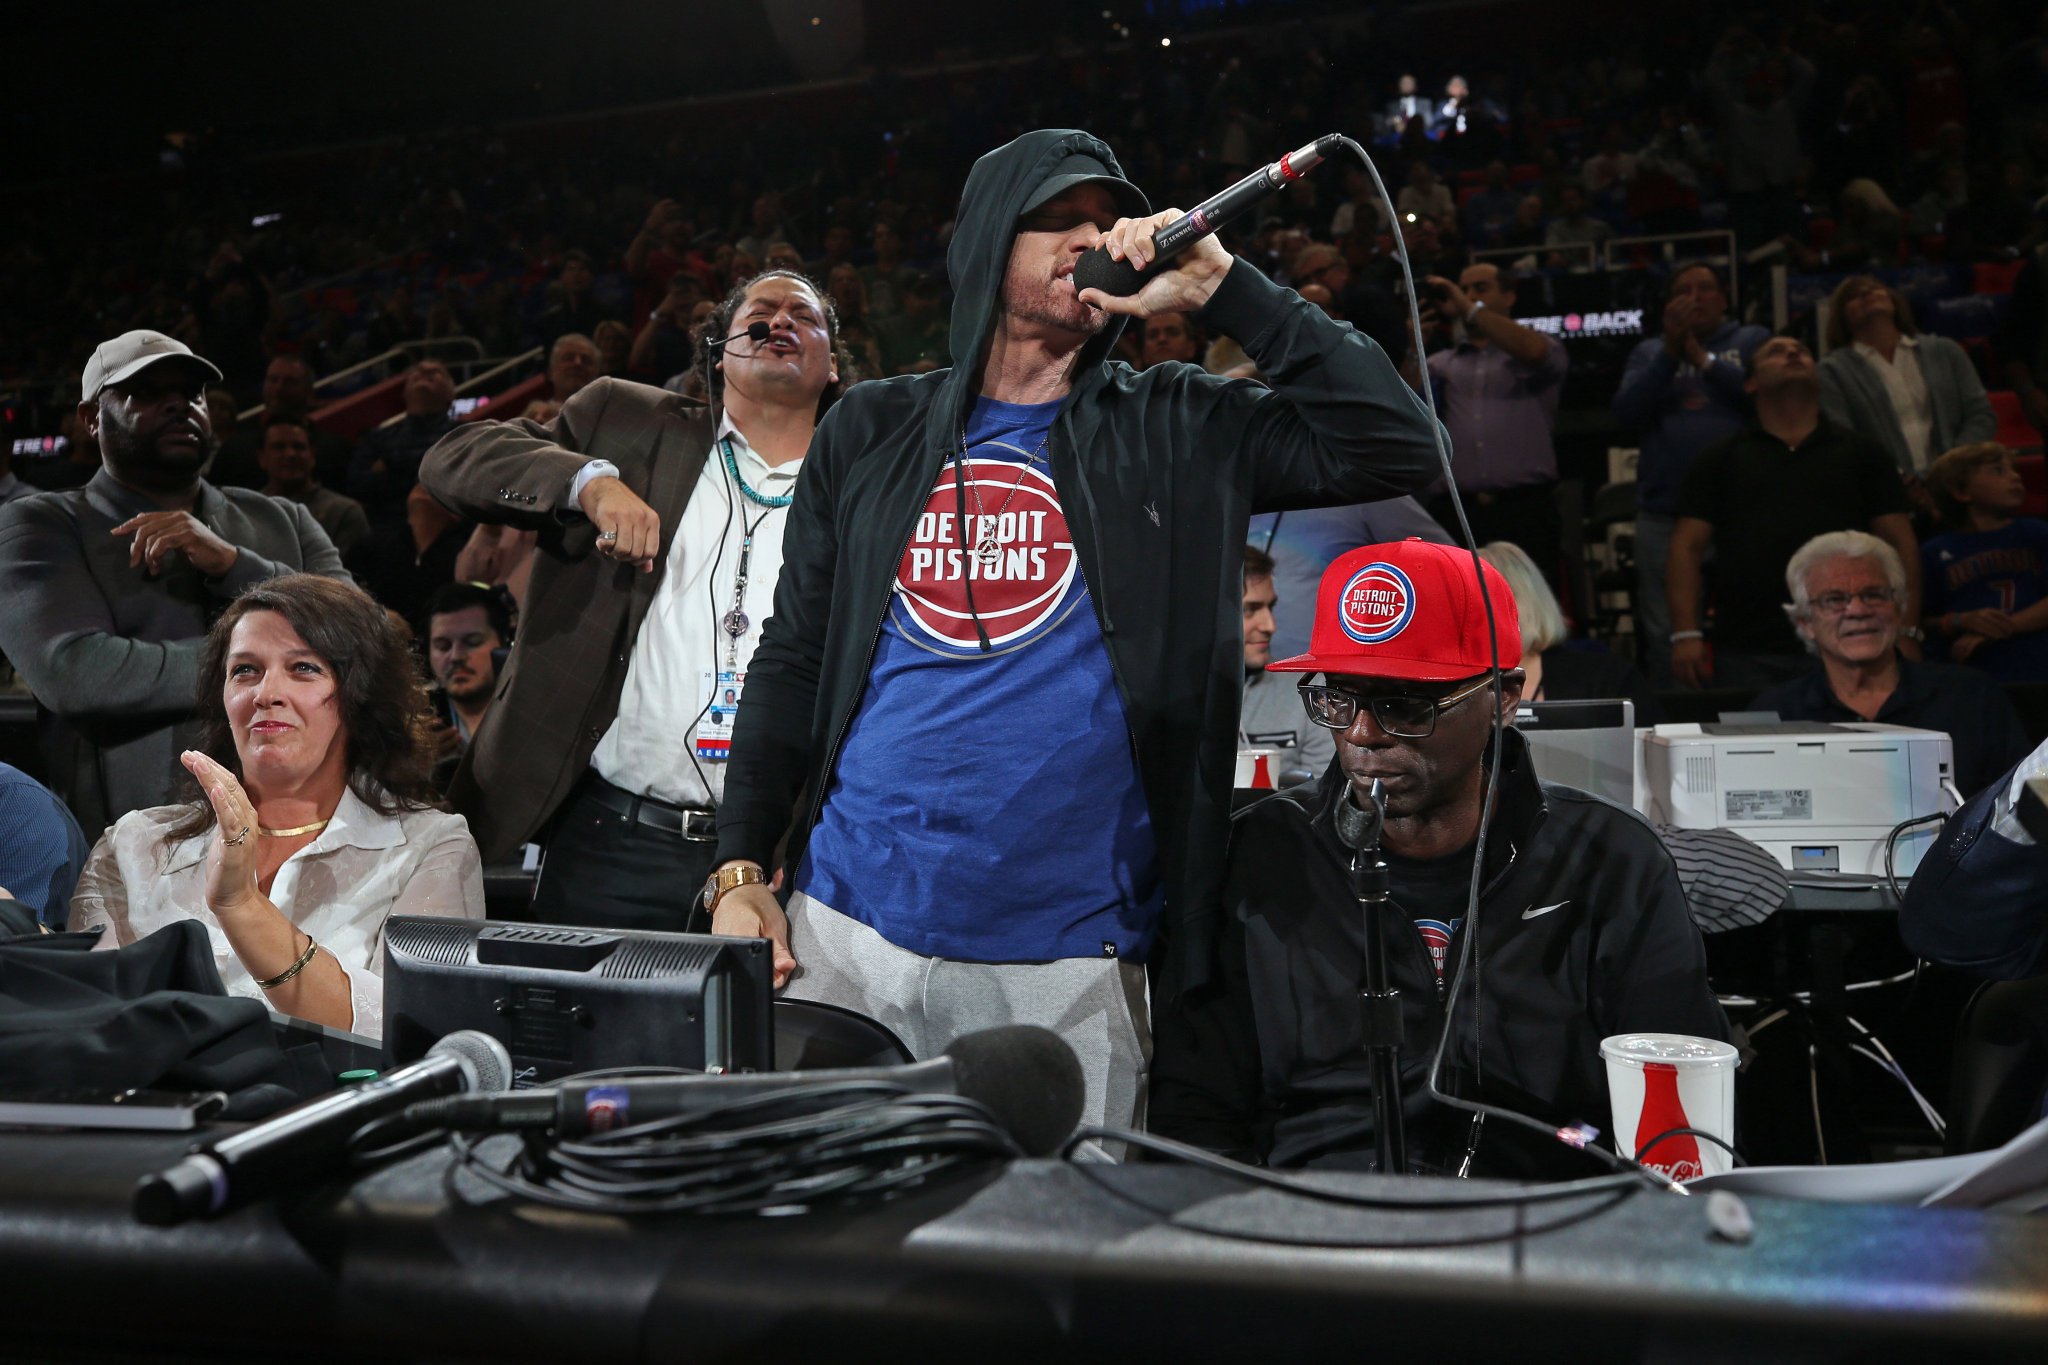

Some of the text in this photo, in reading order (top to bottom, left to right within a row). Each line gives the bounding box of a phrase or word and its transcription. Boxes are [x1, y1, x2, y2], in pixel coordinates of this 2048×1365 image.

[1583, 309, 1644, 331] BACK
[915, 510, 1048, 544] DETROIT
[910, 547, 1048, 582] PISTONS
[1353, 589, 1398, 603] DETROIT
[1350, 602, 1396, 617] PISTONS
